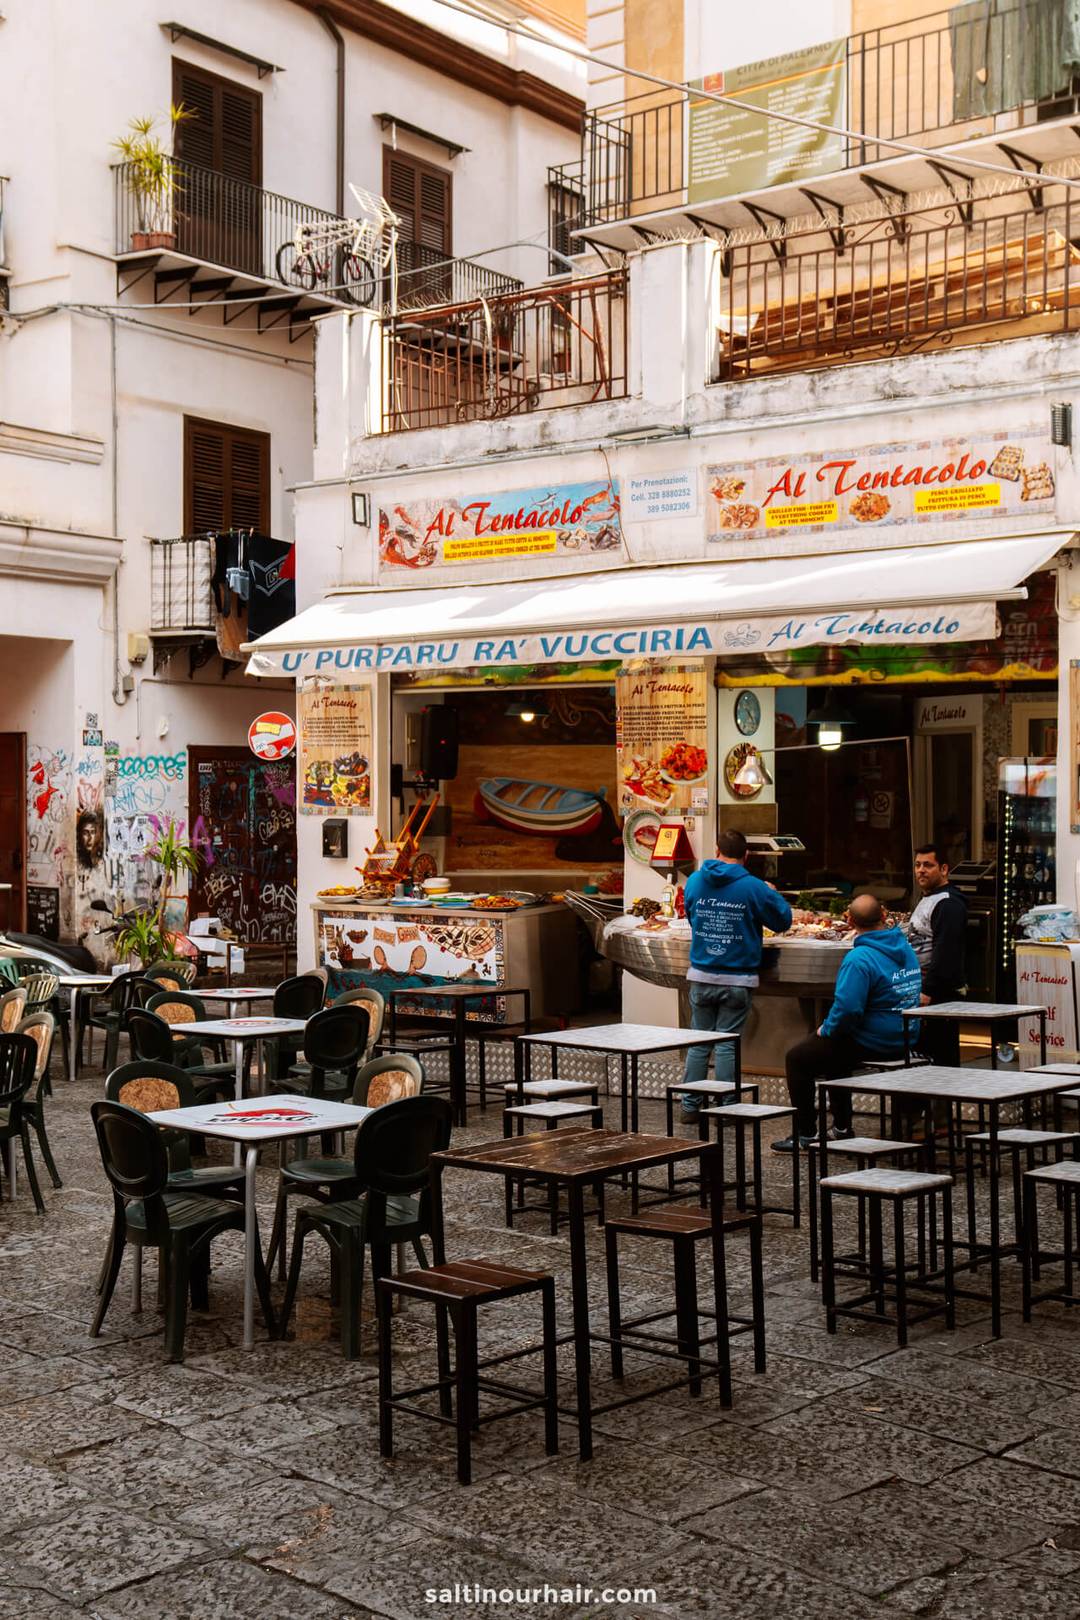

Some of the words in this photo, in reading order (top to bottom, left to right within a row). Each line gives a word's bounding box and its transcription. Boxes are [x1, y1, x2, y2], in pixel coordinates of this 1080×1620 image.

[780, 41, 833, 64] PALERMO
[631, 480, 641, 489] Per
[761, 467, 806, 508] Al
[816, 453, 989, 496] Tentacolo
[422, 507, 455, 546] Al
[462, 499, 583, 537] Tentacolo
[766, 619, 806, 646] Al
[281, 651, 311, 674] U'
[315, 642, 458, 670] PURPARU
[473, 639, 525, 662] RA'
[540, 627, 713, 658] VUCCIRIA
[631, 684, 643, 698] Al
[645, 680, 694, 694] Tentacolo
[311, 699, 320, 711] Al
[321, 696, 357, 709] Tentacolo
[920, 706, 930, 728] Al
[931, 704, 966, 722] Tentacolo
[695, 898, 705, 906] Al
[707, 898, 747, 910] Tentacolo
[1020, 971, 1030, 983] Al
[1031, 971, 1068, 985] Tentacolo
[1028, 1029, 1065, 1047] Sevice
